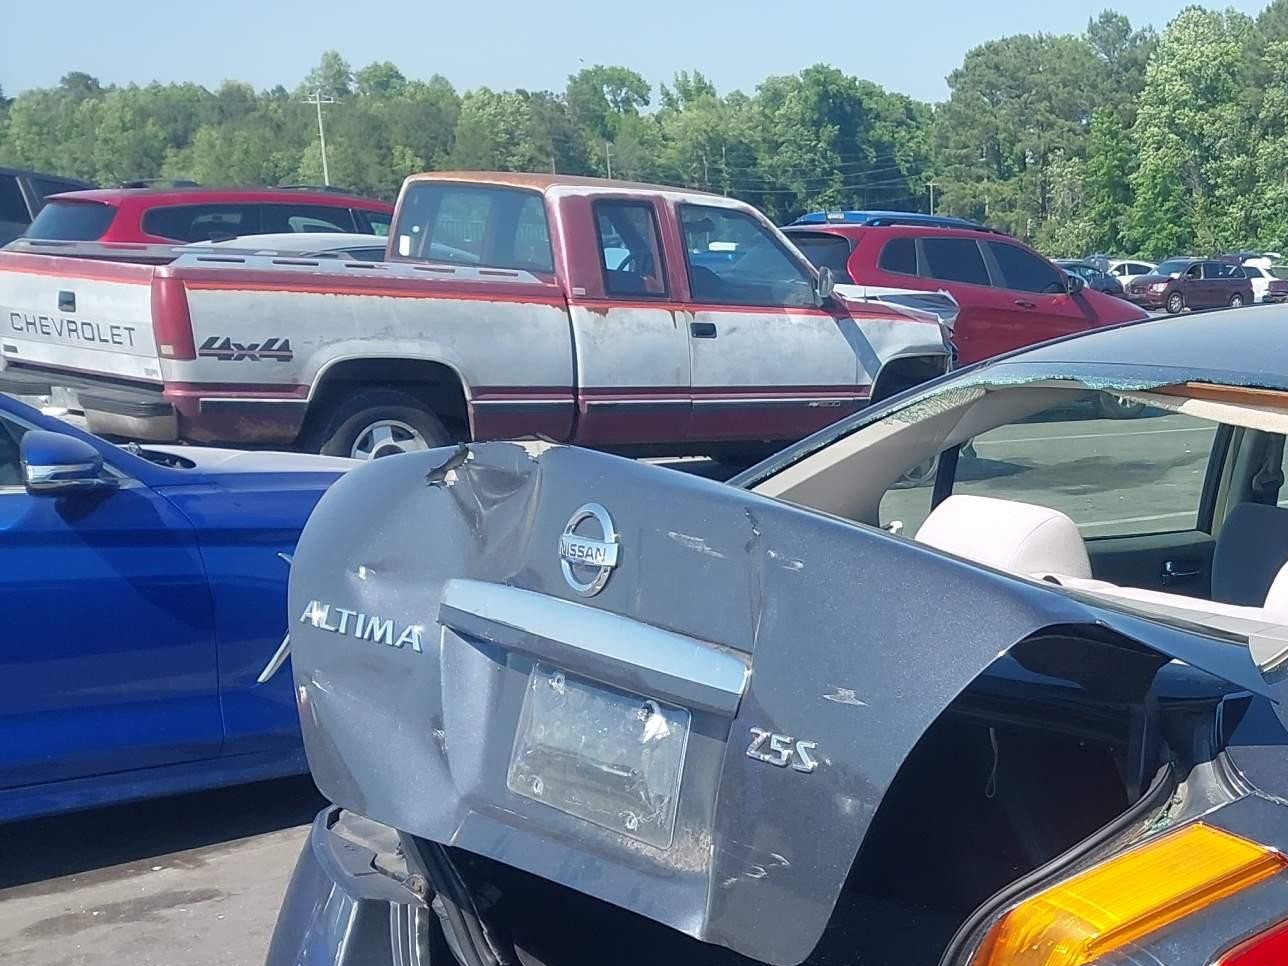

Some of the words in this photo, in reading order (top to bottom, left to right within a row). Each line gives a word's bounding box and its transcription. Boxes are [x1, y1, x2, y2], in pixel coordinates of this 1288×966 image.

[10, 313, 136, 347] CHEVROLET
[199, 336, 294, 362] 4x4
[561, 540, 606, 562] NISSAN
[299, 600, 425, 653] ALTIMA
